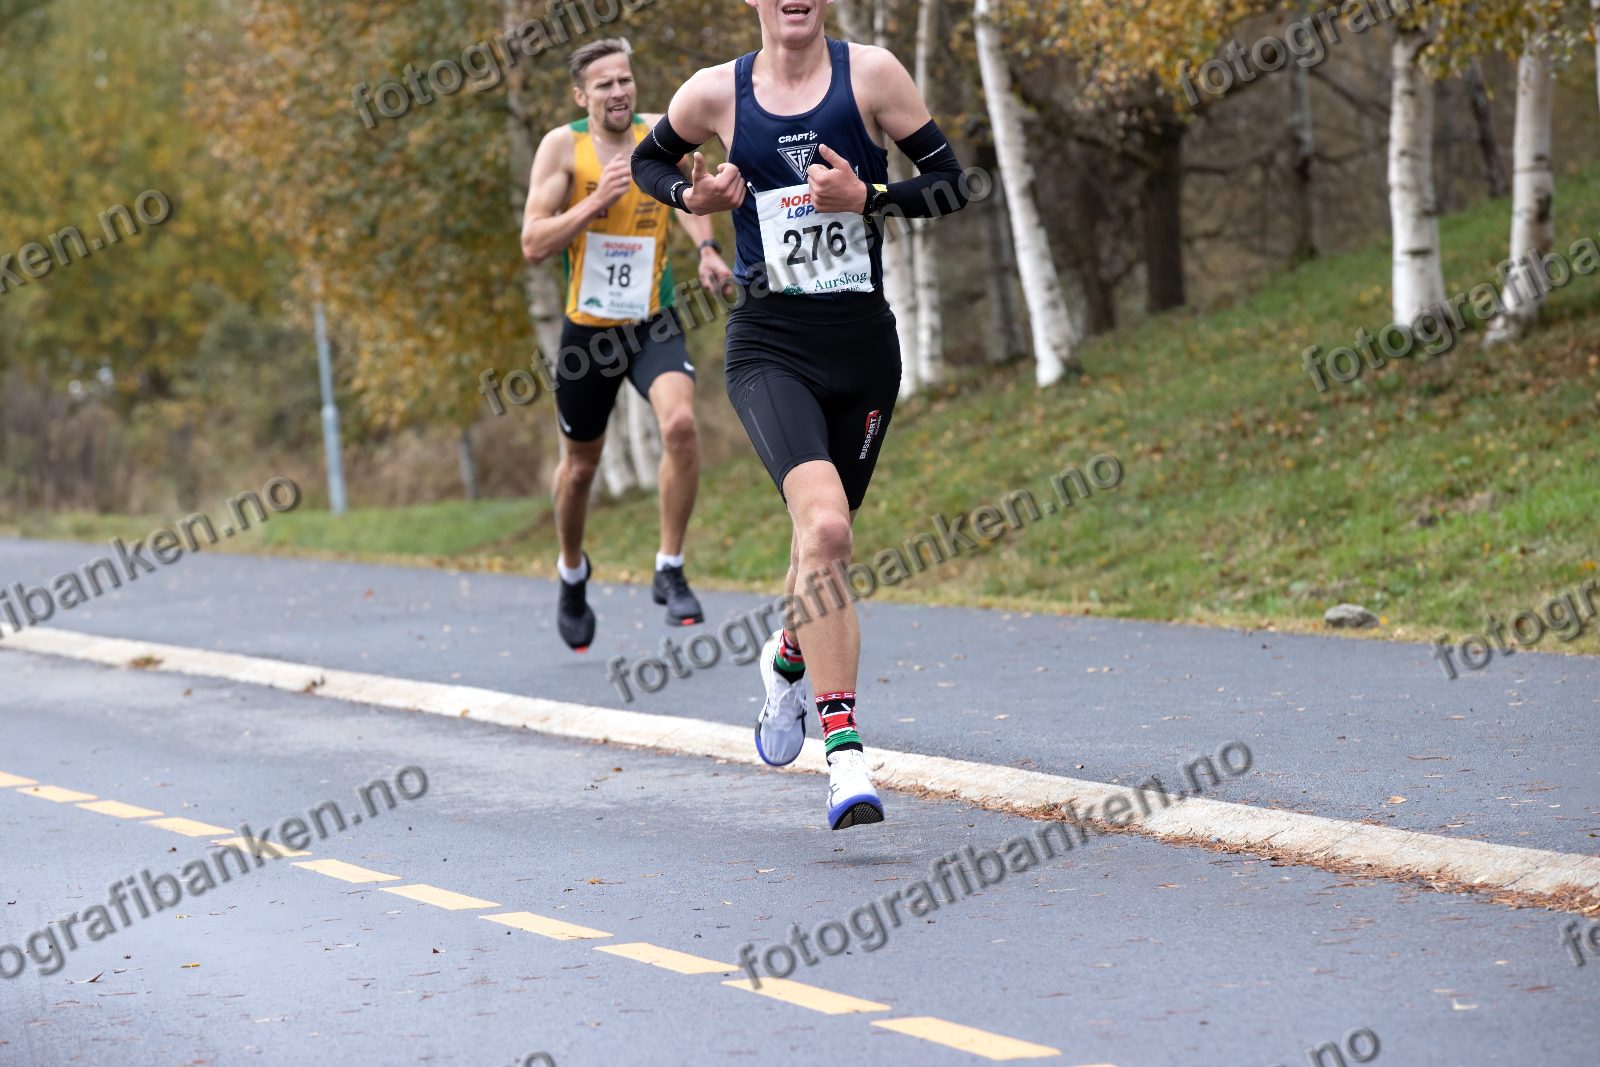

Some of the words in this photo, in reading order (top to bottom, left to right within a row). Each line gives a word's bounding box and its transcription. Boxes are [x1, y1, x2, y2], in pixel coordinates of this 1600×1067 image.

[778, 132, 809, 144] CRAFT
[782, 193, 811, 208] NOR
[787, 205, 816, 219] LØP
[783, 221, 847, 265] 276
[606, 263, 631, 288] 18
[814, 271, 868, 292] Aurskog
